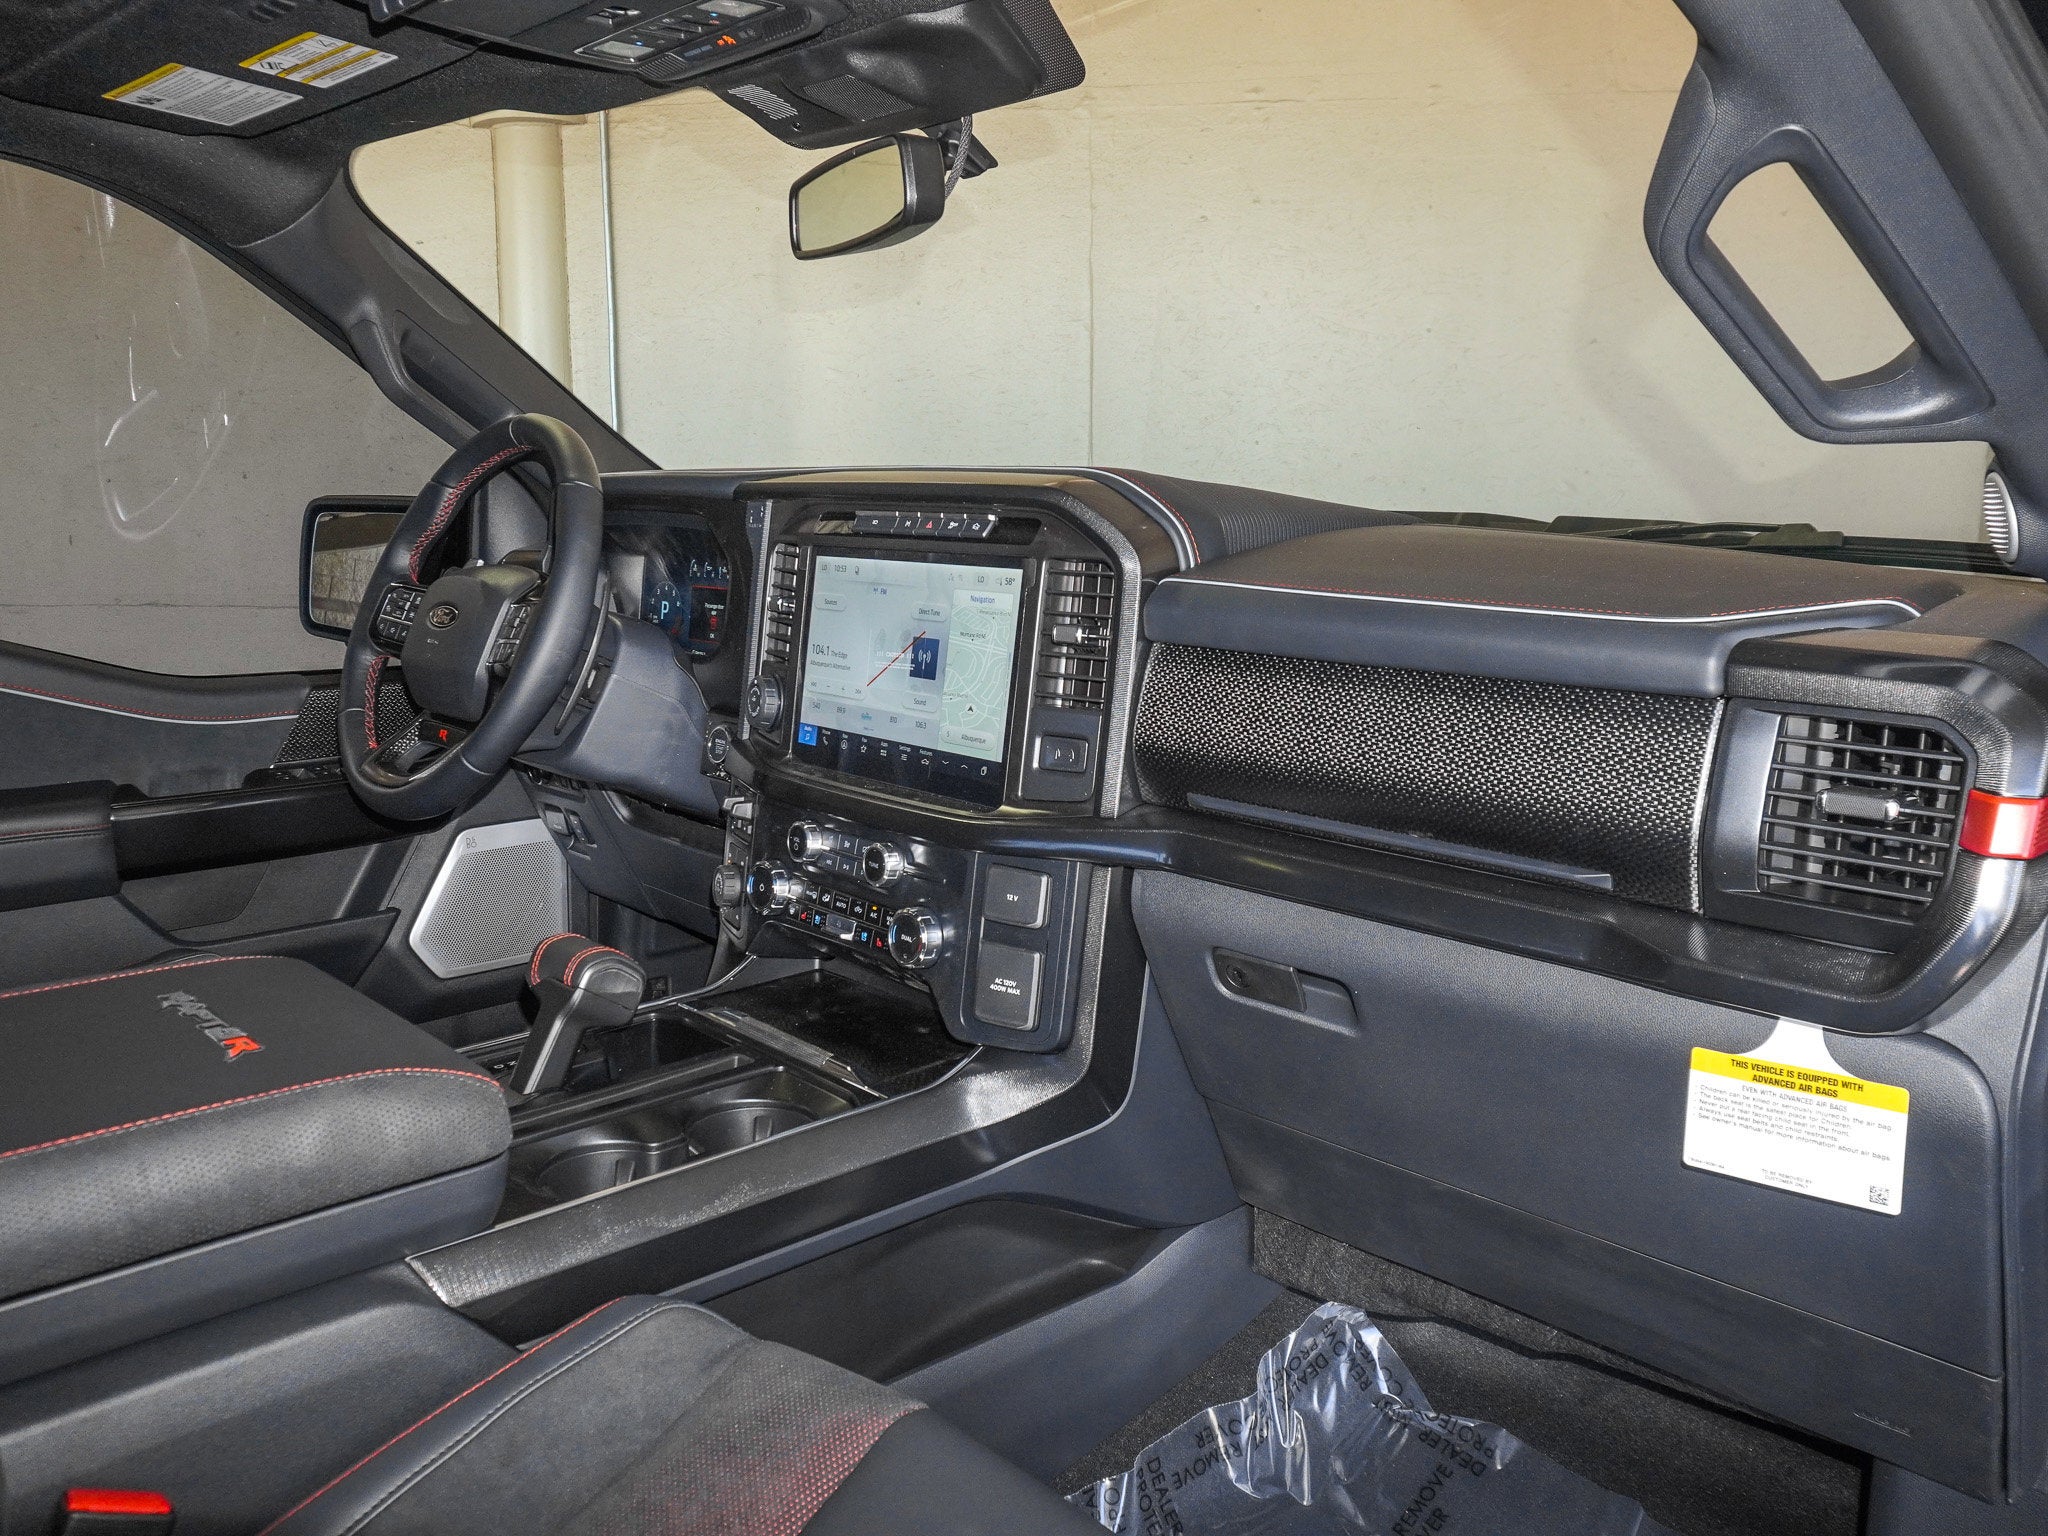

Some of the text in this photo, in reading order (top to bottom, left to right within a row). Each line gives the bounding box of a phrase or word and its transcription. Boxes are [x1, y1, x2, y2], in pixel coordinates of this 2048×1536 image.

[970, 595, 995, 604] Navigation
[660, 600, 670, 620] P
[811, 643, 830, 656] 104.1
[913, 697, 927, 706] Sound
[901, 933, 912, 943] DUAL
[994, 977, 1017, 988] AC 120V
[989, 983, 1021, 996] 400W MAX
[1730, 1058, 1864, 1092] THIS VEHICLE IS EQUIPPED WITH
[1700, 1084, 1727, 1094] Children
[1752, 1074, 1838, 1098] ADVANCED AIR BAGS
[1699, 1098, 1718, 1107] Never
[1741, 1085, 1758, 1094] EVEN
[1760, 1090, 1777, 1098] WITH
[1779, 1093, 1814, 1106] ADVANCED
[1829, 1103, 1848, 1112] BAGS
[1699, 1106, 1721, 1116] Always
[1698, 1112, 1710, 1120] See
[1795, 1135, 1836, 1149] information
[1418, 1429, 1487, 1477] DEALER
[1146, 1456, 1183, 1536] DEALER
[1393, 1462, 1453, 1536] REMOVE
